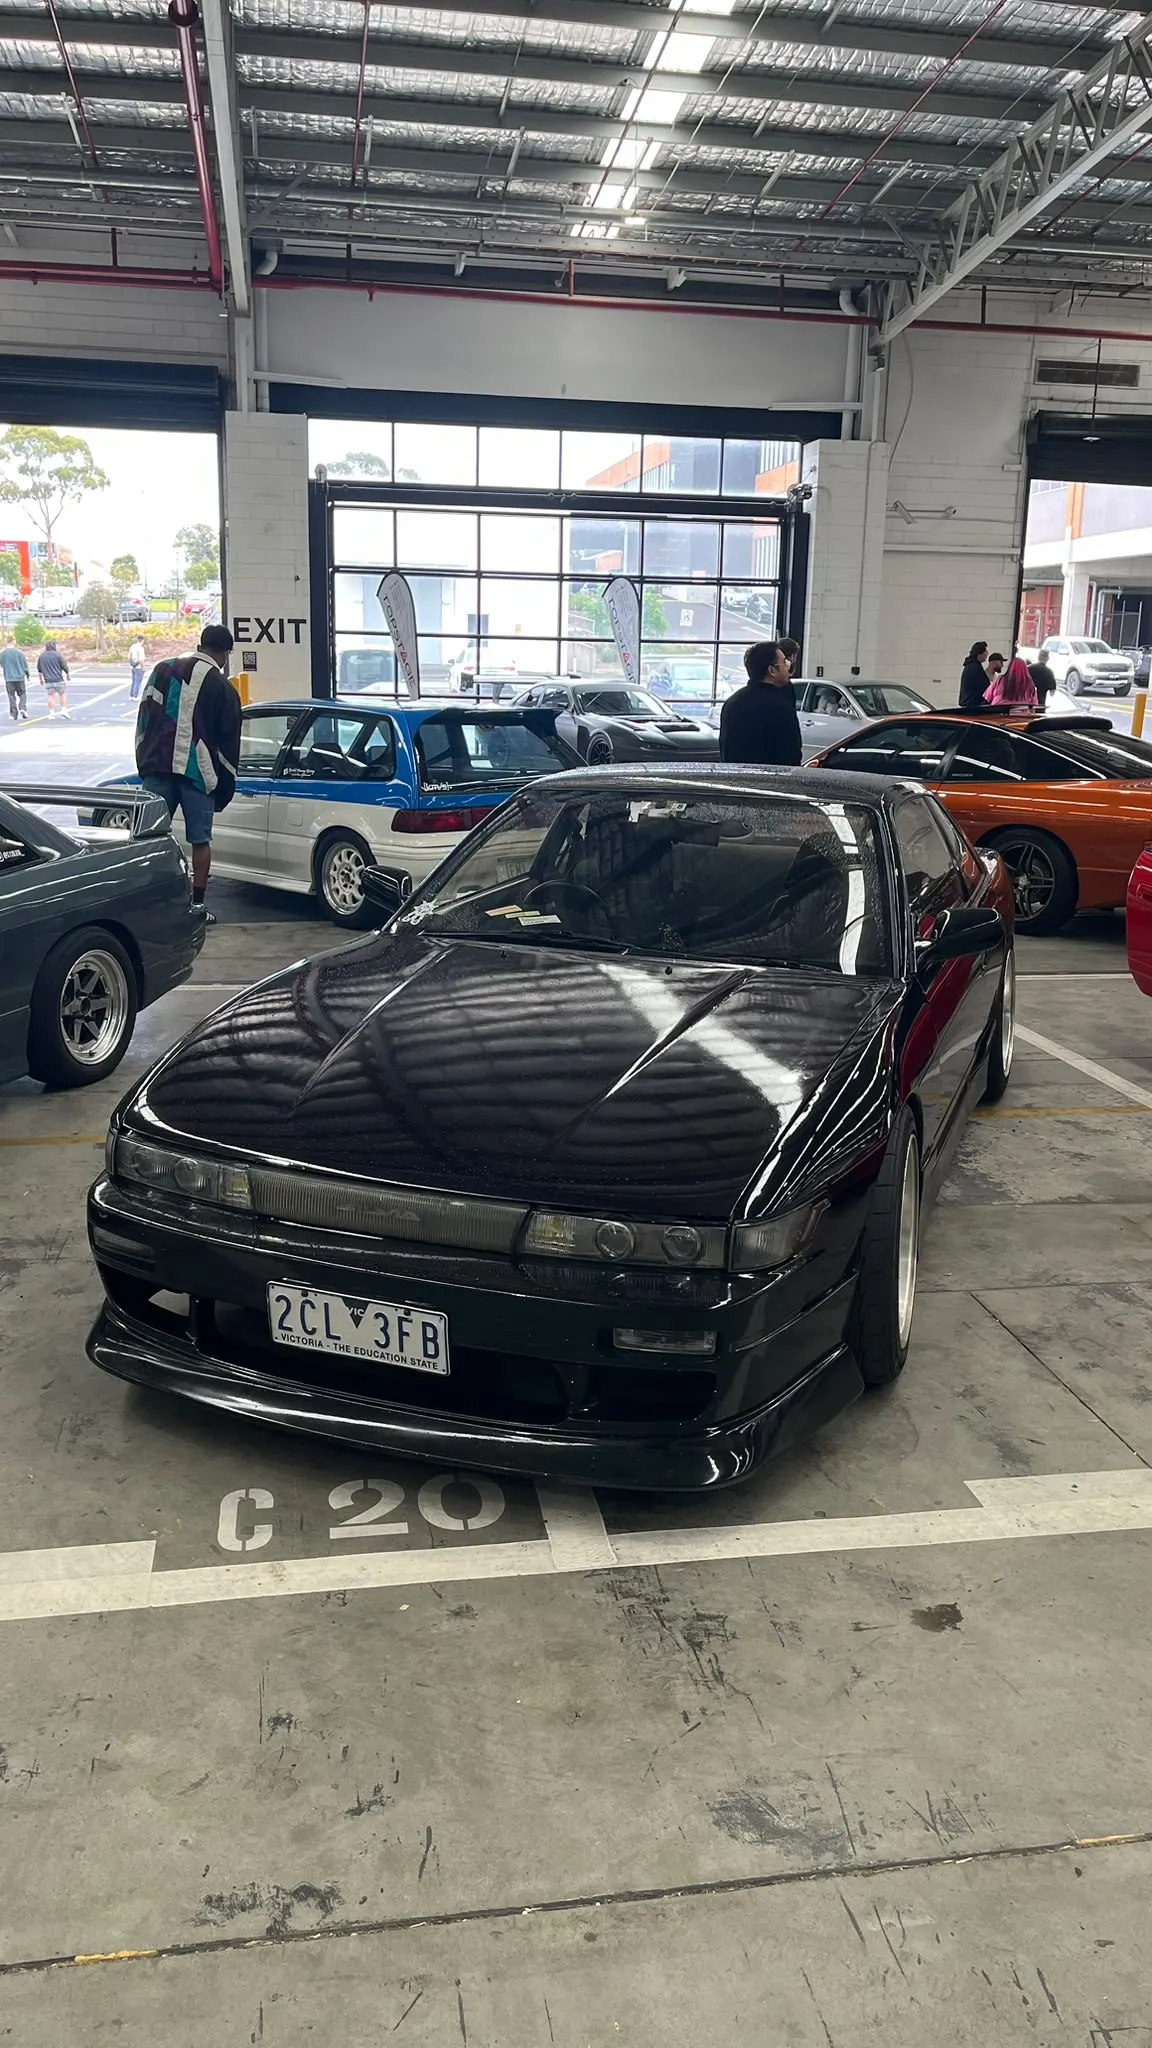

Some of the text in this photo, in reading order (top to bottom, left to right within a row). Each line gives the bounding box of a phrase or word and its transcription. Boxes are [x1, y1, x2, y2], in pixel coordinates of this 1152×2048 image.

[233, 617, 307, 644] EXIT
[275, 1295, 440, 1359] 2CL 3FB
[281, 1333, 324, 1349] VICTORIA
[333, 1342, 351, 1353] THE
[354, 1346, 408, 1365] EDUCATION
[410, 1358, 438, 1370] STATE
[217, 1473, 506, 1551] C 20
